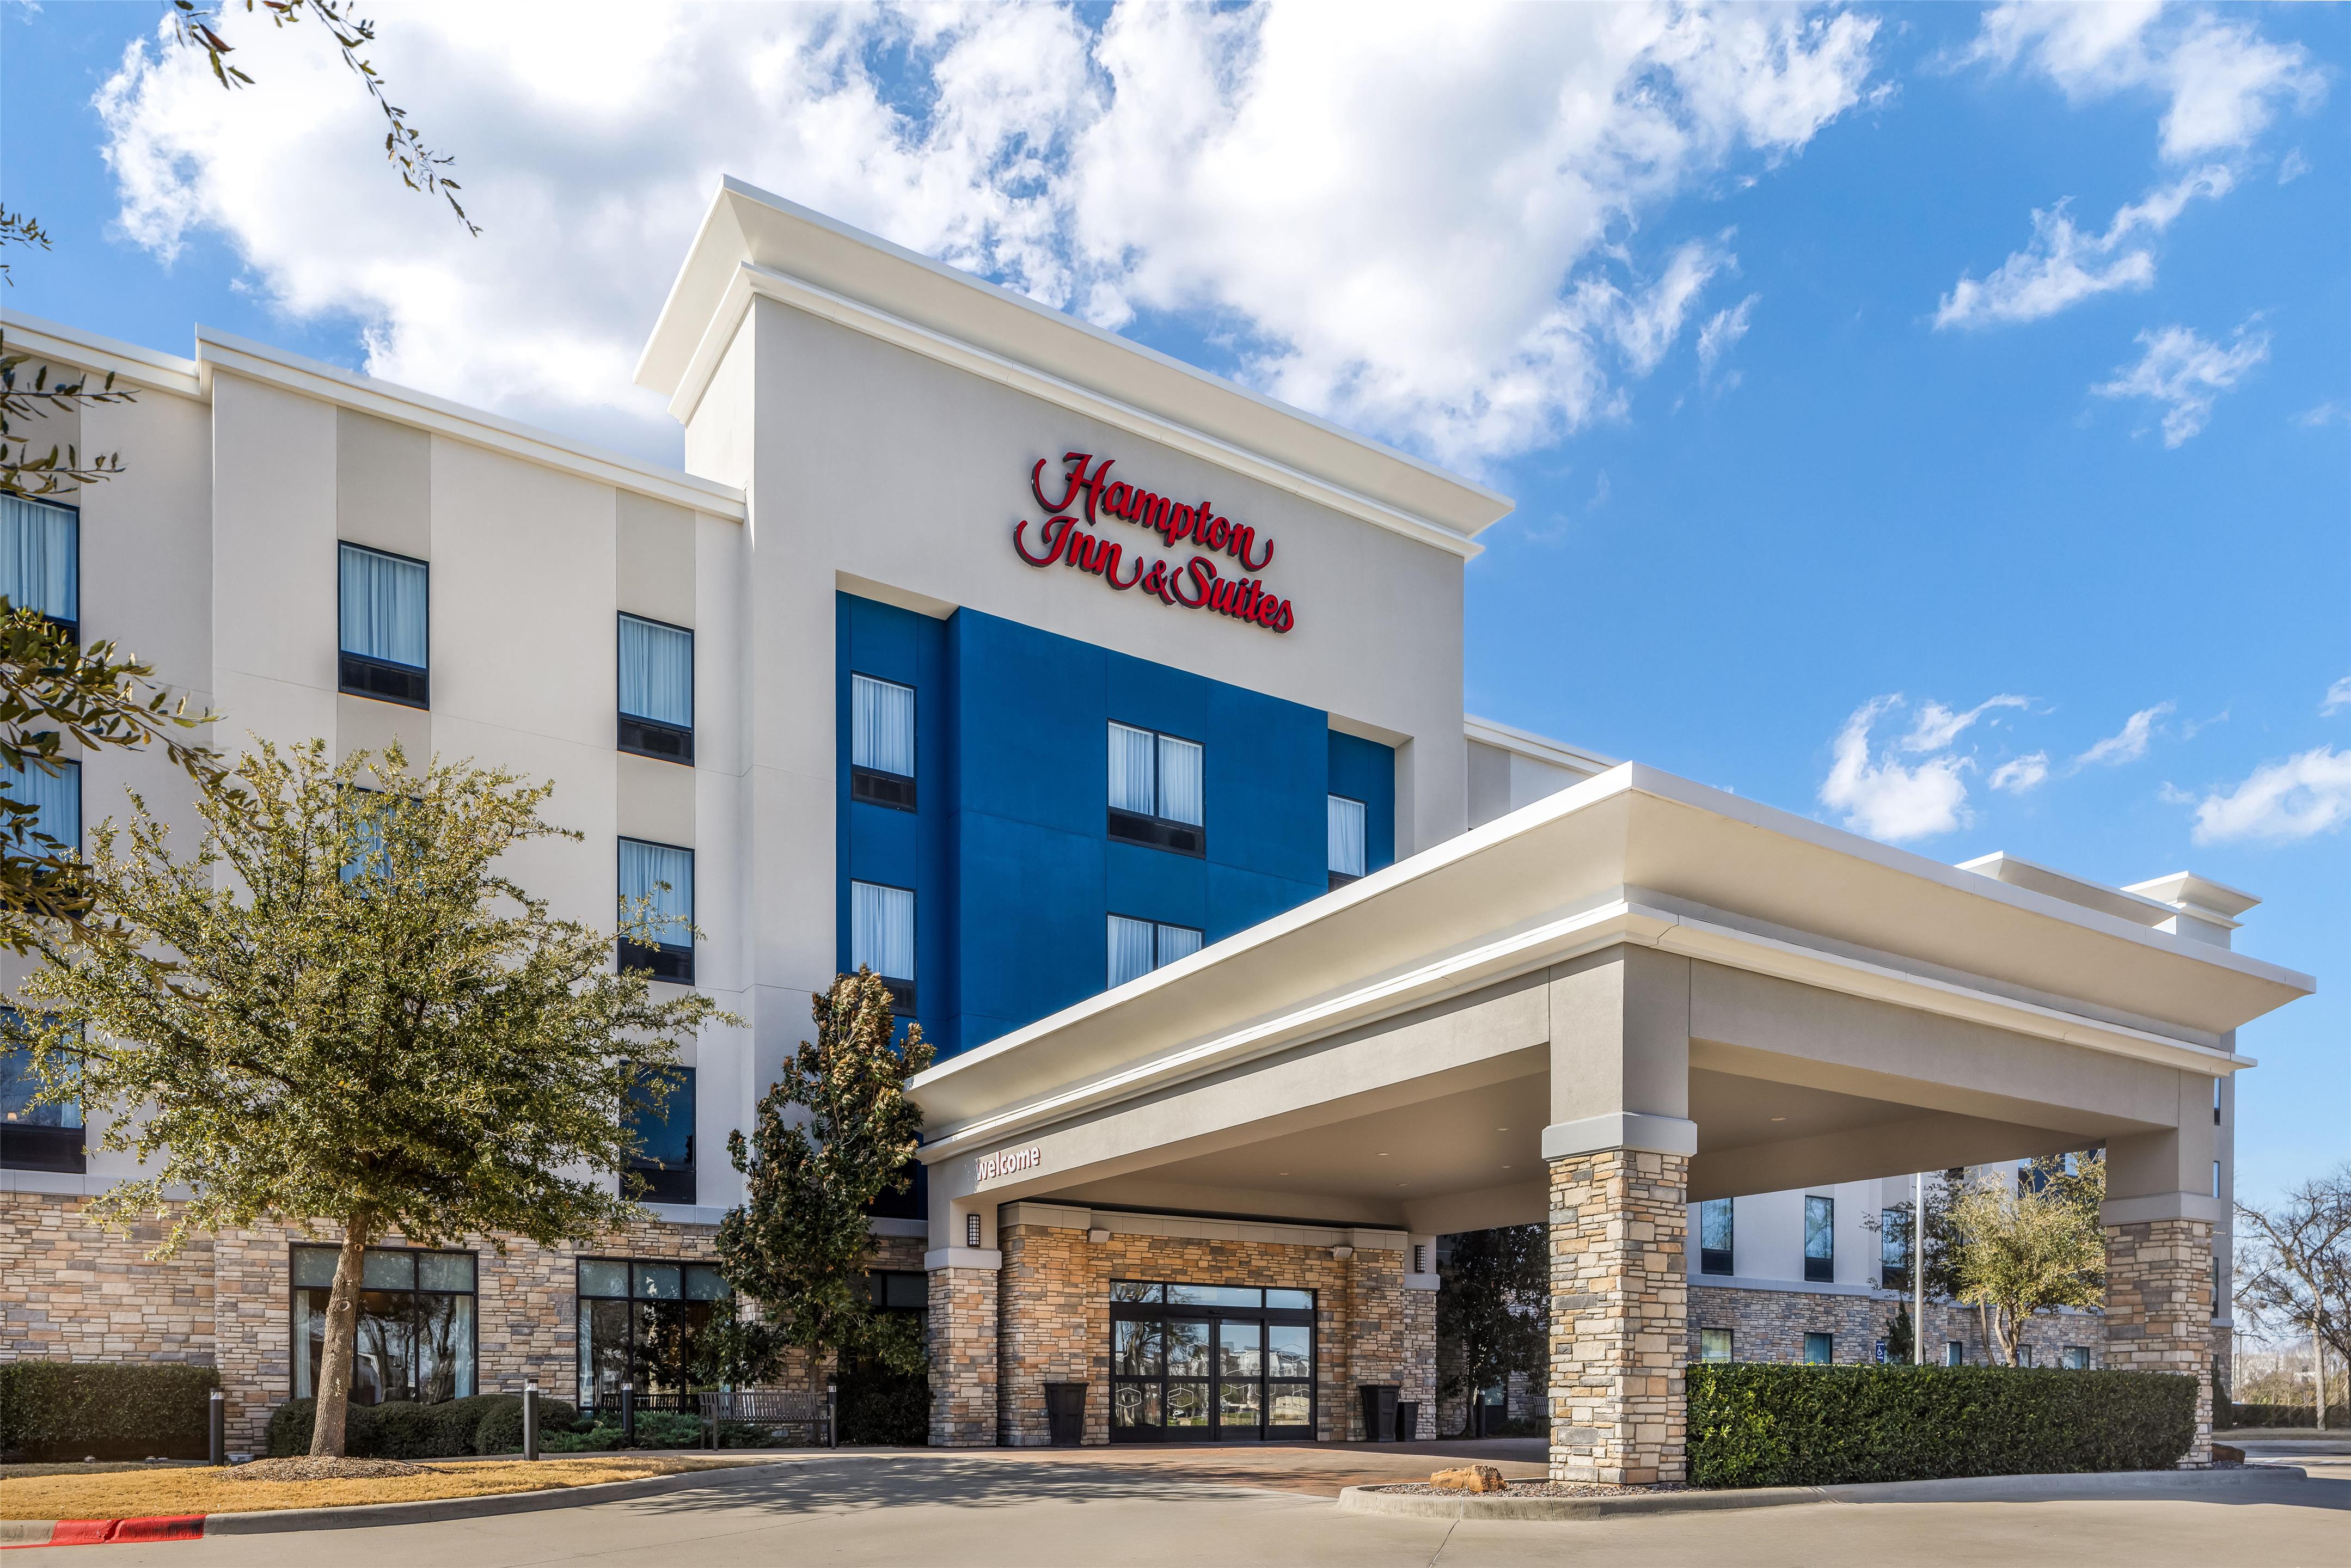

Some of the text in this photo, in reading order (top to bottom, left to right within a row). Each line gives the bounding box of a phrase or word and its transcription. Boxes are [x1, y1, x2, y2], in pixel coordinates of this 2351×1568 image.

[1032, 451, 1274, 572] Hampton
[1013, 516, 1294, 634] Inn & Suites
[976, 1147, 1040, 1181] welcome
